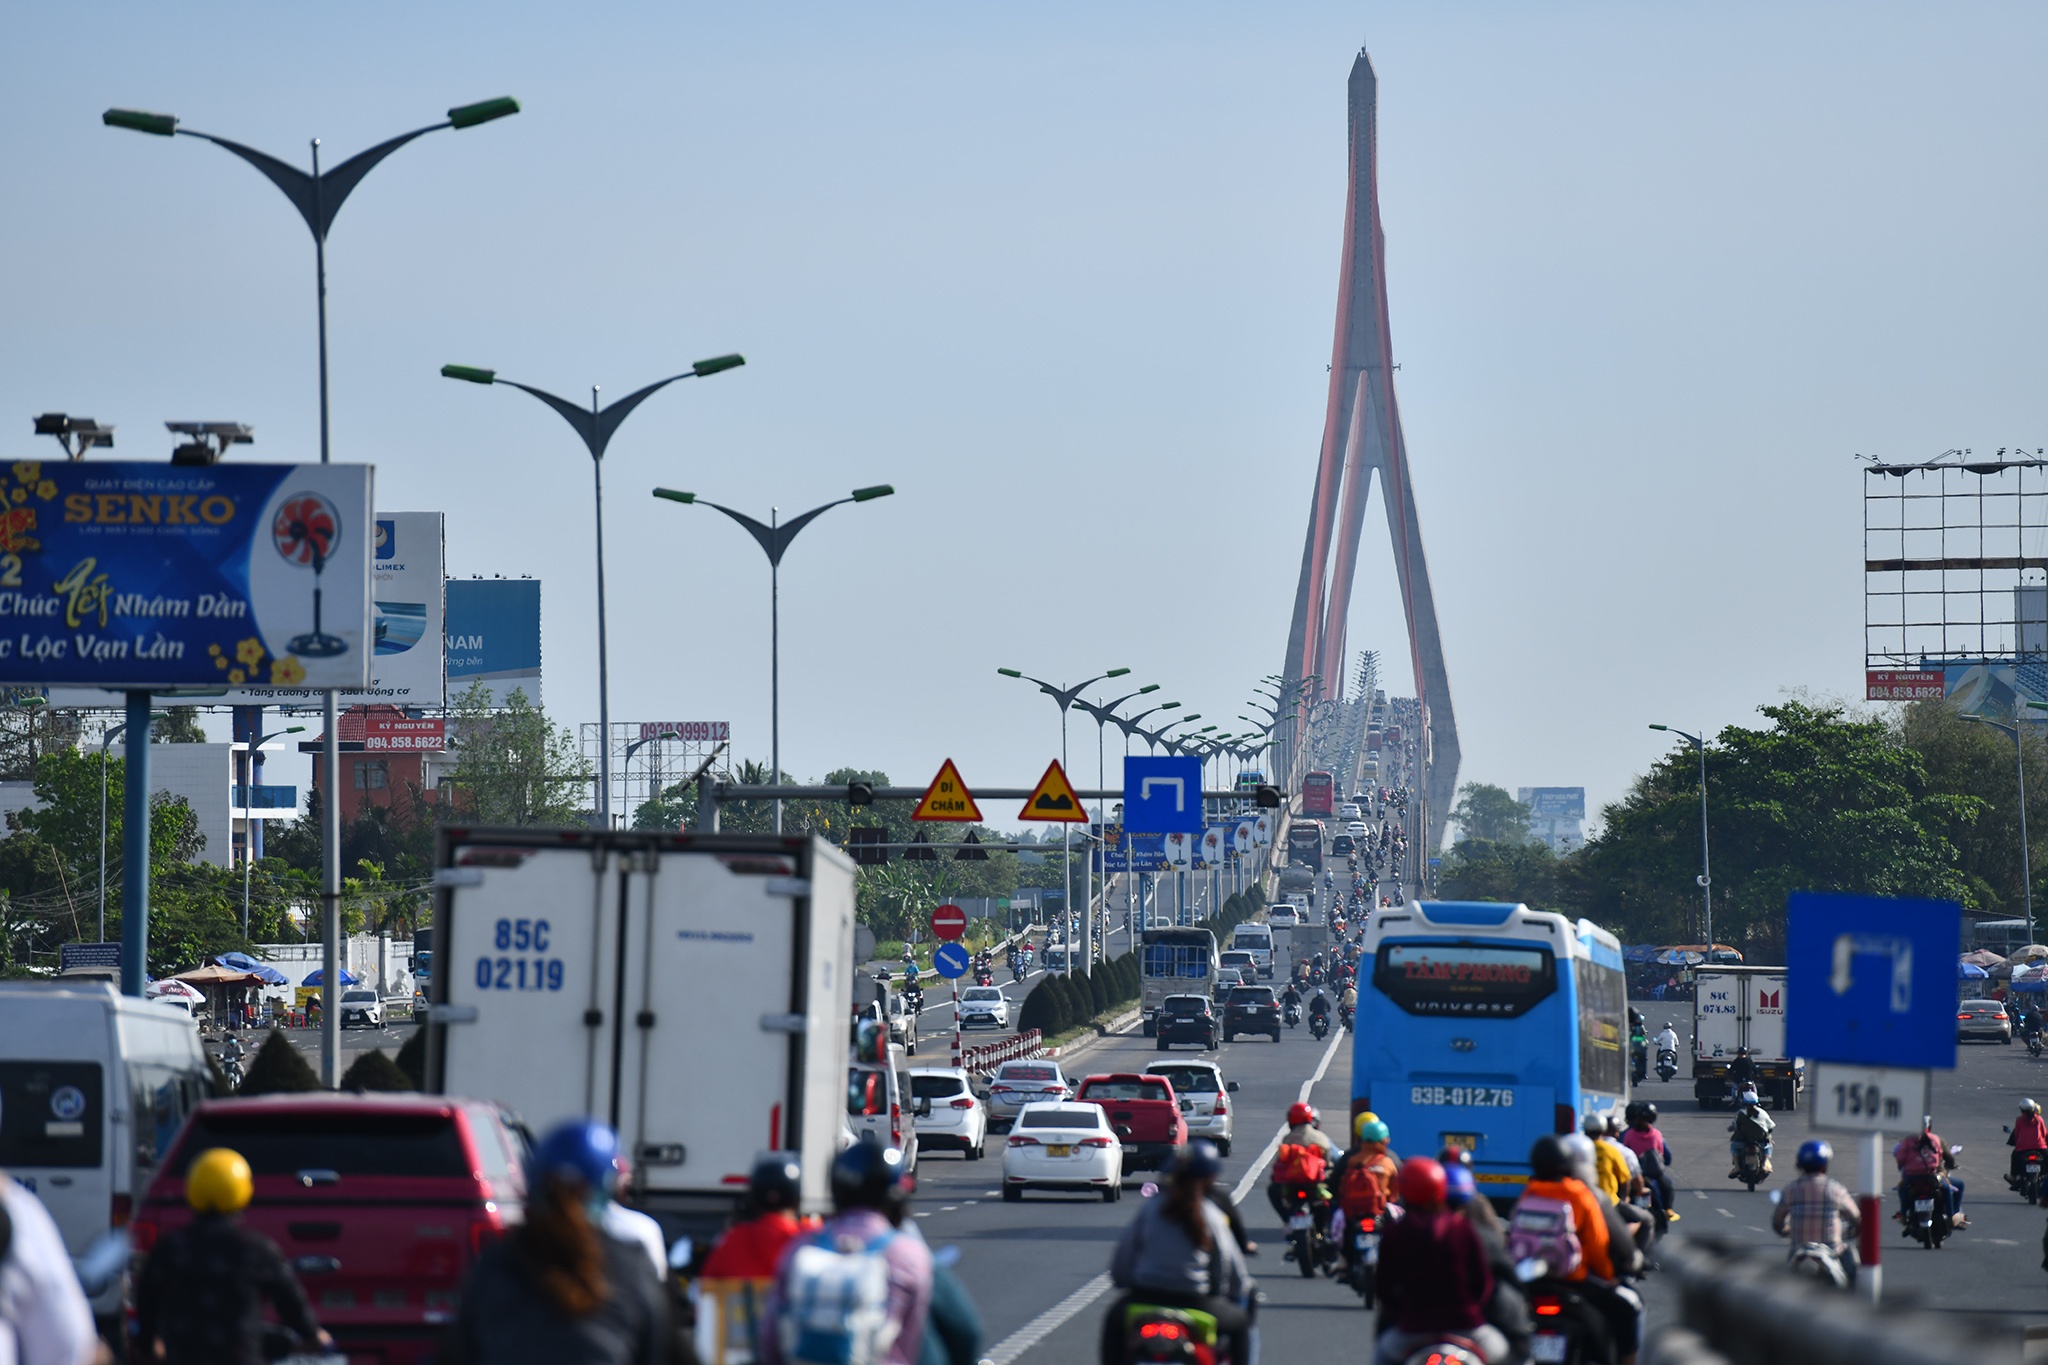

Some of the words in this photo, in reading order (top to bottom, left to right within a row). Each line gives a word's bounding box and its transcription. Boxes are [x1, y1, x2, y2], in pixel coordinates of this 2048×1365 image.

[157, 480, 186, 490] CAO
[64, 494, 236, 525] SENKO
[0, 592, 60, 615] Chúc
[114, 593, 190, 617] Nhâm
[196, 592, 247, 618] Dần
[20, 634, 67, 663] Lộc
[75, 634, 128, 662] Vạn
[135, 632, 186, 660] Lần
[446, 635, 484, 650] NAM
[1869, 686, 1942, 698] 094.858.6622
[676, 721, 709, 741] 9999
[711, 721, 727, 741] 12
[367, 736, 443, 750] 094.858.6622
[931, 798, 965, 813] CHẬM
[494, 918, 551, 952] 85C
[1415, 1001, 1515, 1012] UNIVERSE
[1703, 1004, 1736, 1014] 074.83
[1411, 1086, 1514, 1107] 83B-012.76
[1833, 1082, 1880, 1117] 150
